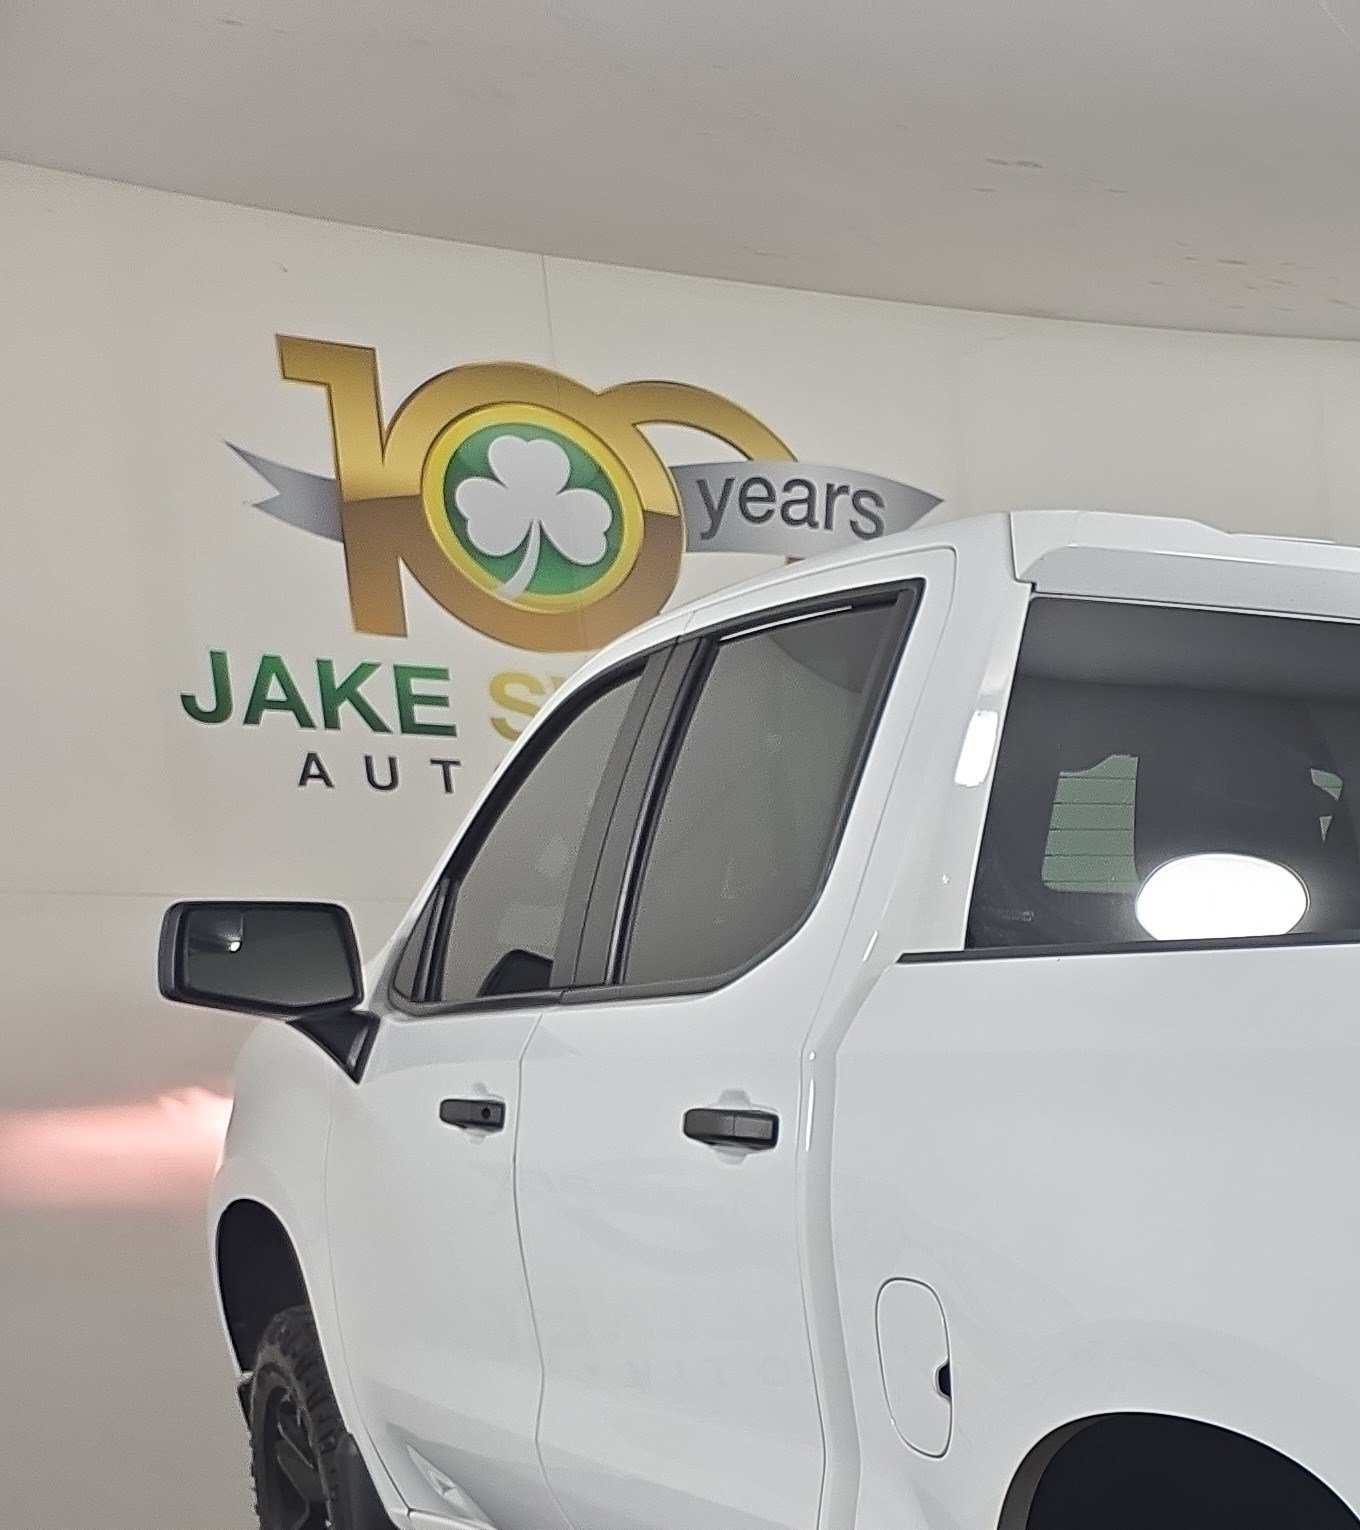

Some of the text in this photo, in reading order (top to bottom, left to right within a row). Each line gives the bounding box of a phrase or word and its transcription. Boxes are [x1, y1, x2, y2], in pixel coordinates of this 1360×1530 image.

[696, 473, 886, 542] years
[181, 649, 457, 737] JAKE
[298, 751, 501, 795] AUT
